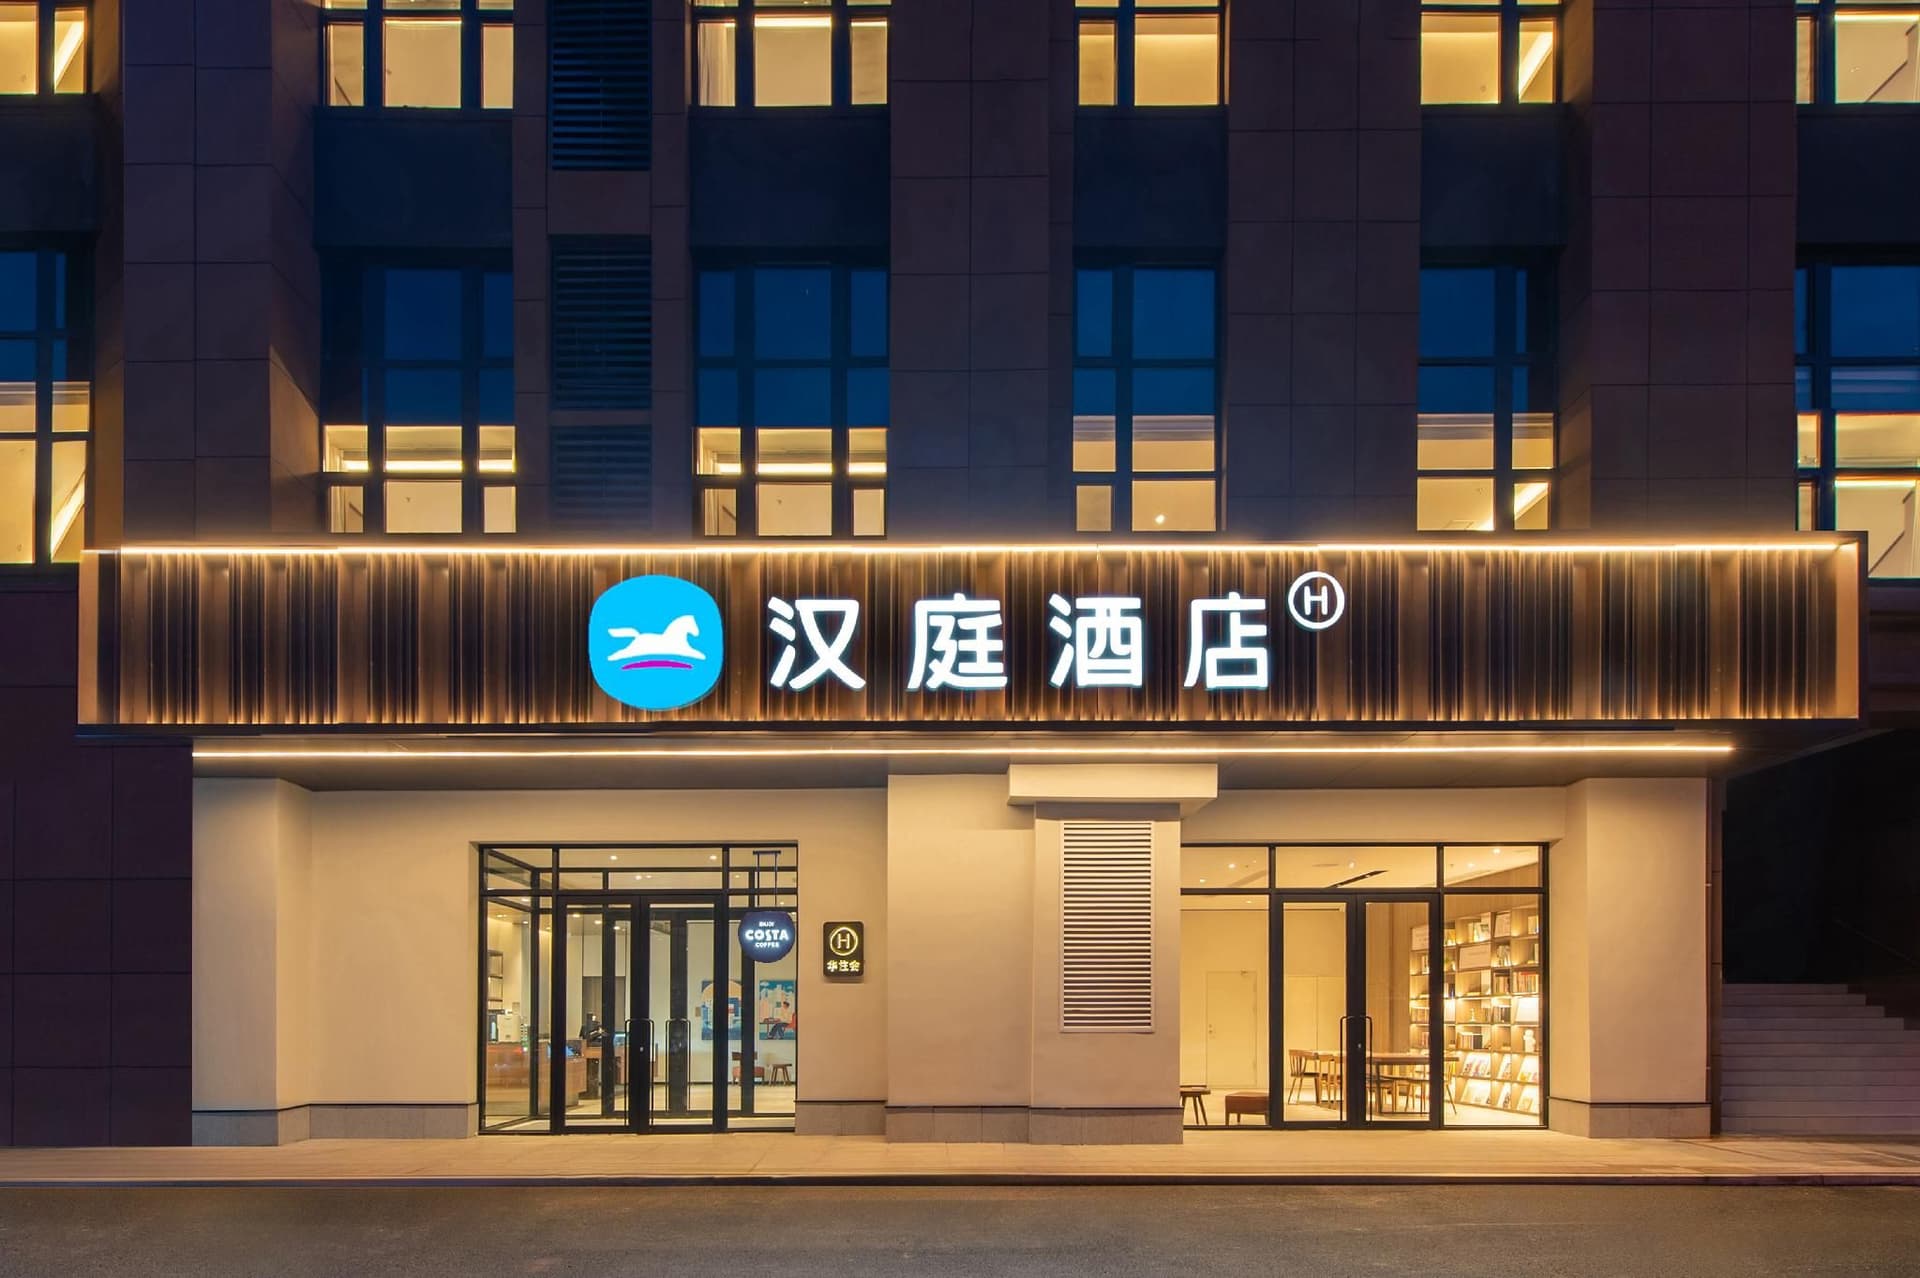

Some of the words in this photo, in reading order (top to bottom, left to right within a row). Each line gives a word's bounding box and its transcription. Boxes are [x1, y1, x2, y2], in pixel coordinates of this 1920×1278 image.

[767, 591, 1270, 691] 汉庭酒店
[745, 929, 789, 941] COSTA
[826, 960, 860, 972] 华住会
